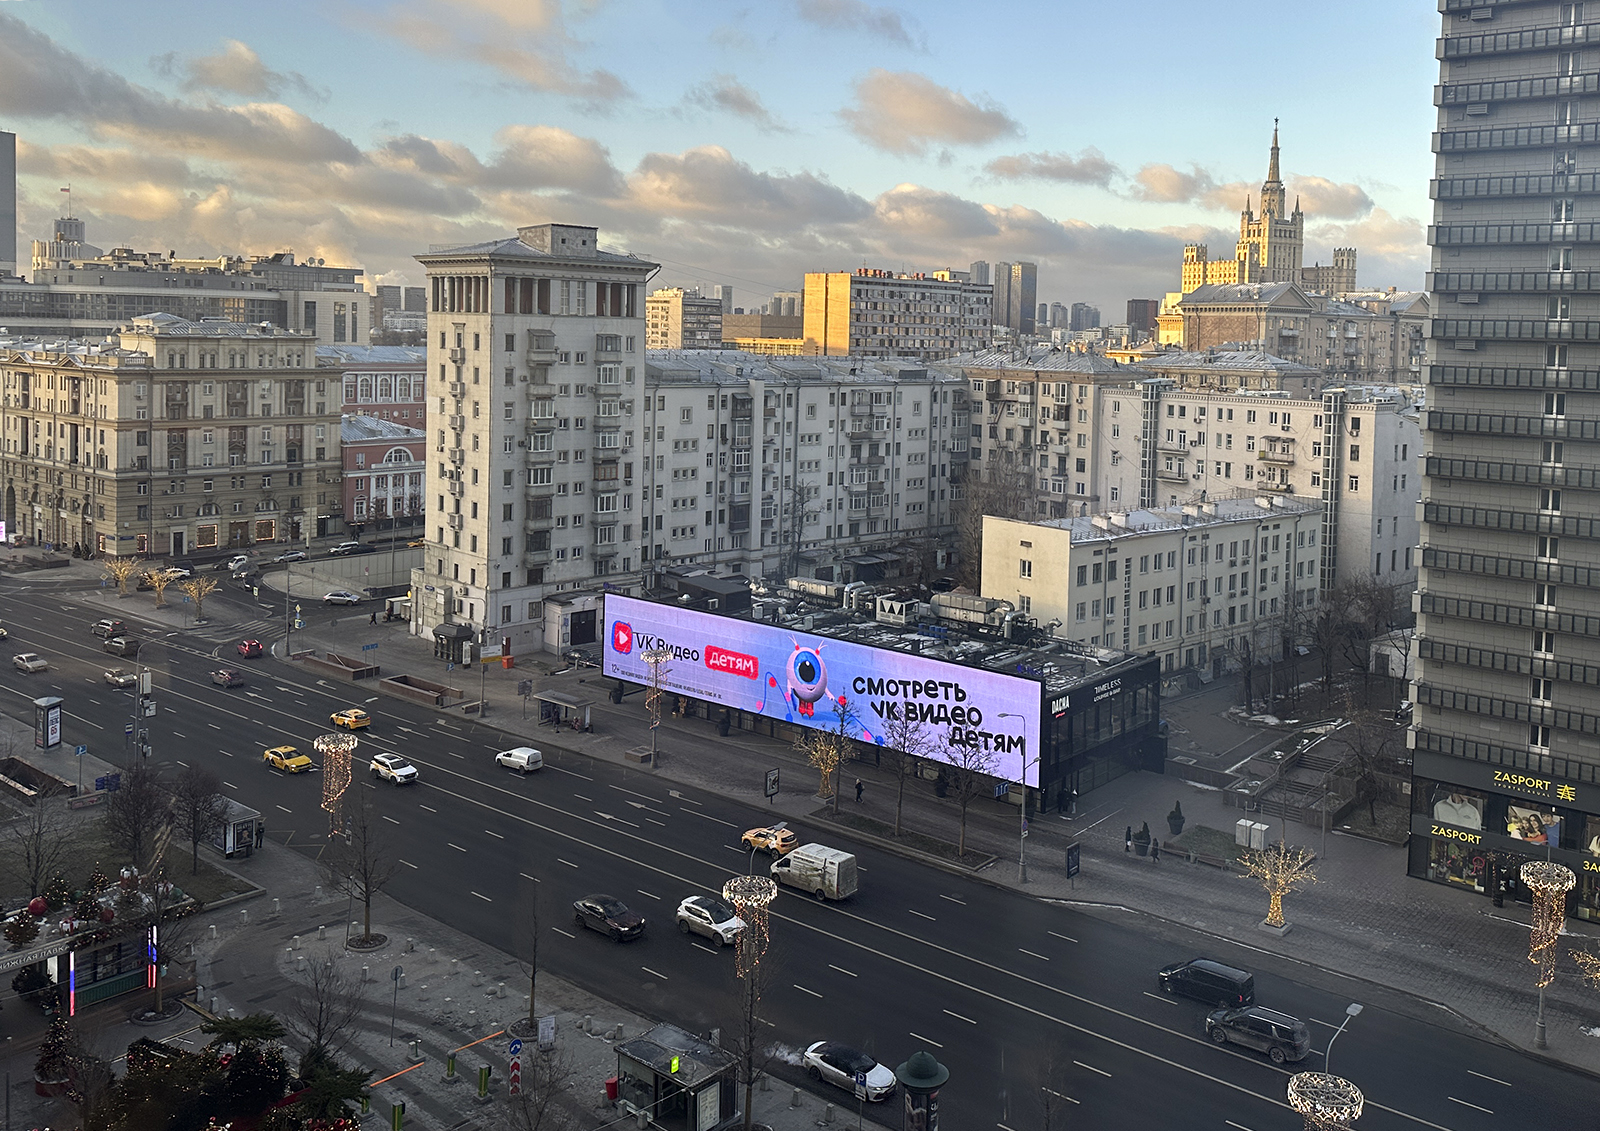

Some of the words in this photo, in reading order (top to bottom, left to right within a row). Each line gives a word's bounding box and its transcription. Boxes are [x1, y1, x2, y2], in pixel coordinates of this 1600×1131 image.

[636, 632, 654, 652] VK
[657, 638, 700, 662] Видео
[709, 653, 754, 674] детям
[1094, 678, 1122, 694] TIMELESS
[1493, 770, 1552, 791] ZASPORT
[1431, 825, 1482, 845] ZASPORT
